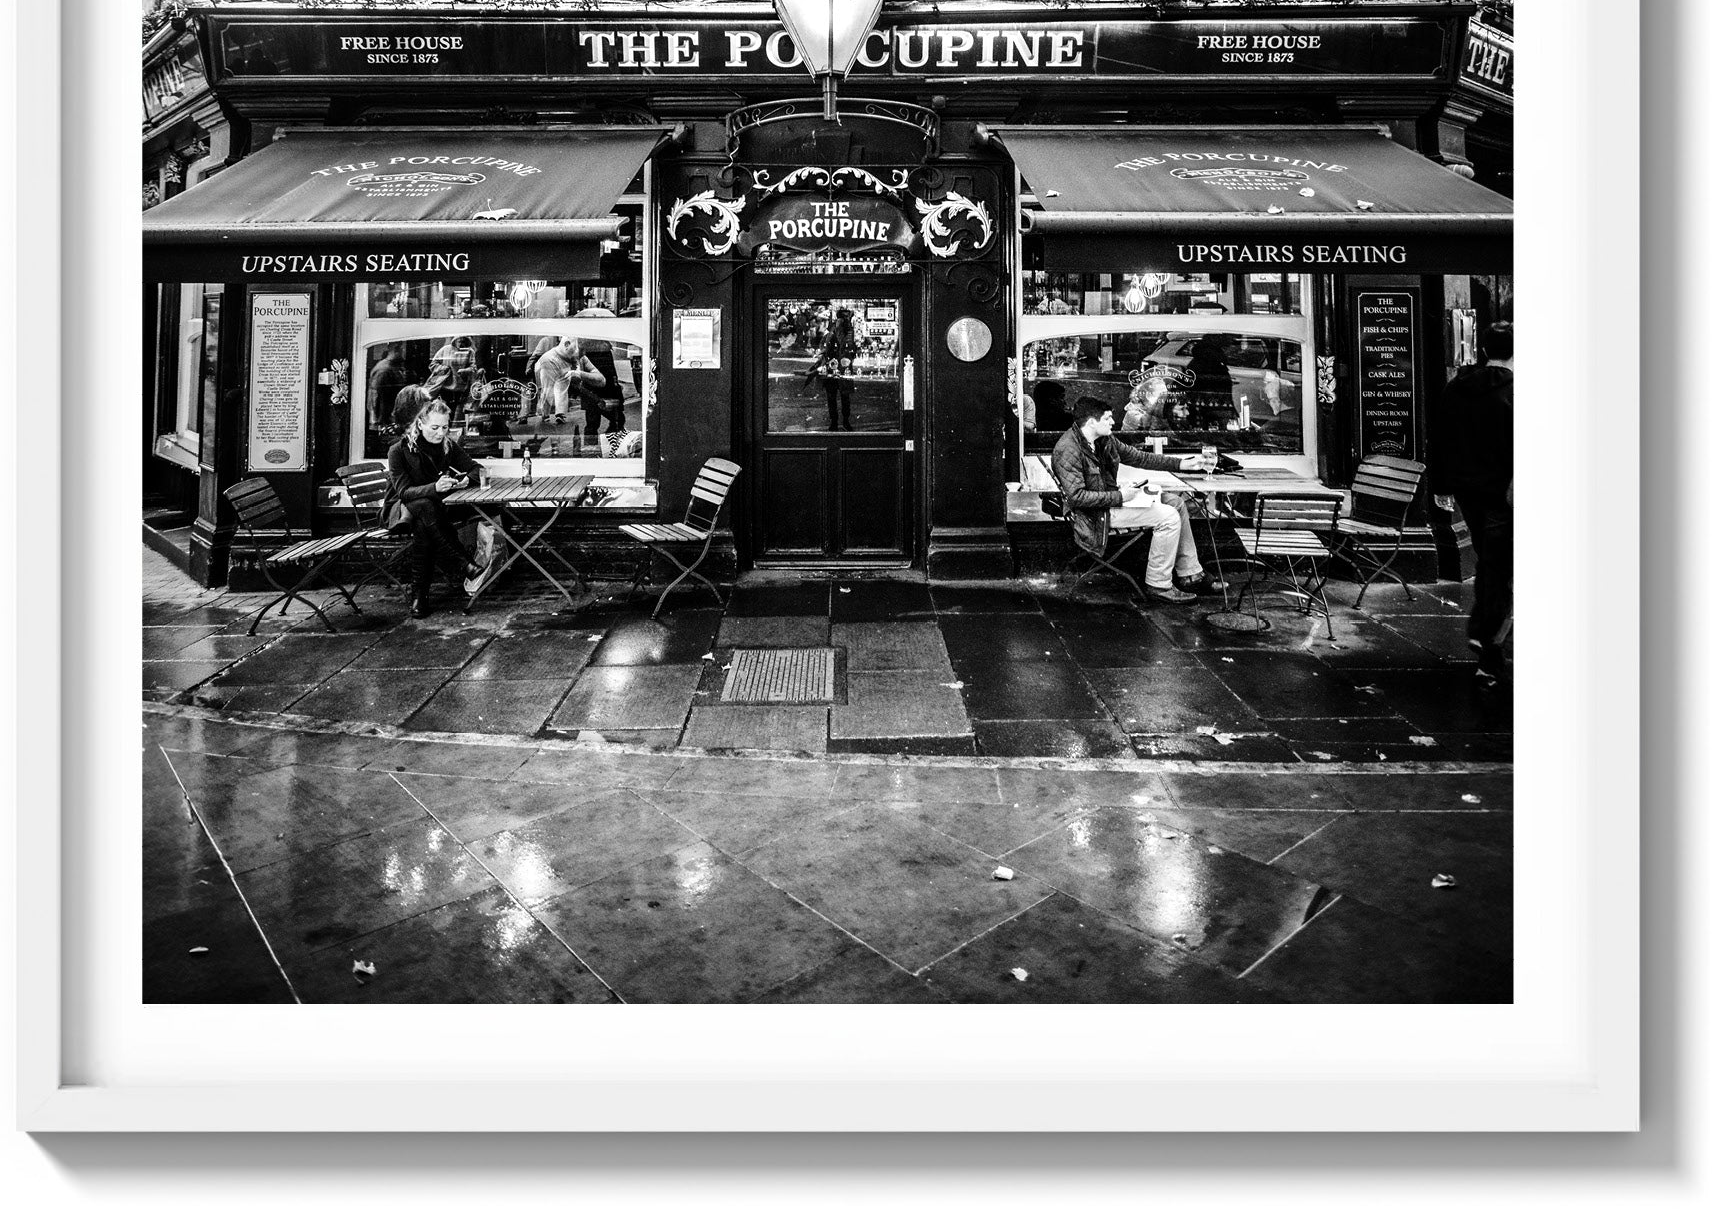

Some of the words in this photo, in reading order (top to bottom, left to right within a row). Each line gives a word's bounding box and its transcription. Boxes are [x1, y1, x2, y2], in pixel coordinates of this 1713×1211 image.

[340, 37, 391, 50] FREE
[396, 37, 463, 50] HOUSE
[579, 31, 699, 67] THE
[724, 30, 1083, 68] POCUPINE
[1197, 36, 1248, 49] FREE
[1252, 36, 1321, 49] HOUSE
[367, 54, 408, 64] SINCE
[412, 54, 439, 64] 1873
[1222, 53, 1263, 63] SINCE
[1267, 53, 1294, 63] 1873
[1467, 35, 1510, 85] THE
[311, 161, 379, 178] THE
[388, 156, 542, 178] PORCUPINE
[1114, 156, 1166, 171] THE
[1162, 152, 1349, 173] PORCUPINE
[810, 202, 849, 217] THE
[769, 218, 890, 241] PORCUPINE
[1177, 245, 1294, 263] UPSTAIRS
[1302, 245, 1407, 263] SEATING
[242, 255, 358, 273] UPSTAIRS
[366, 254, 470, 272] SEATING
[254, 307, 308, 316] PORCUPINE
